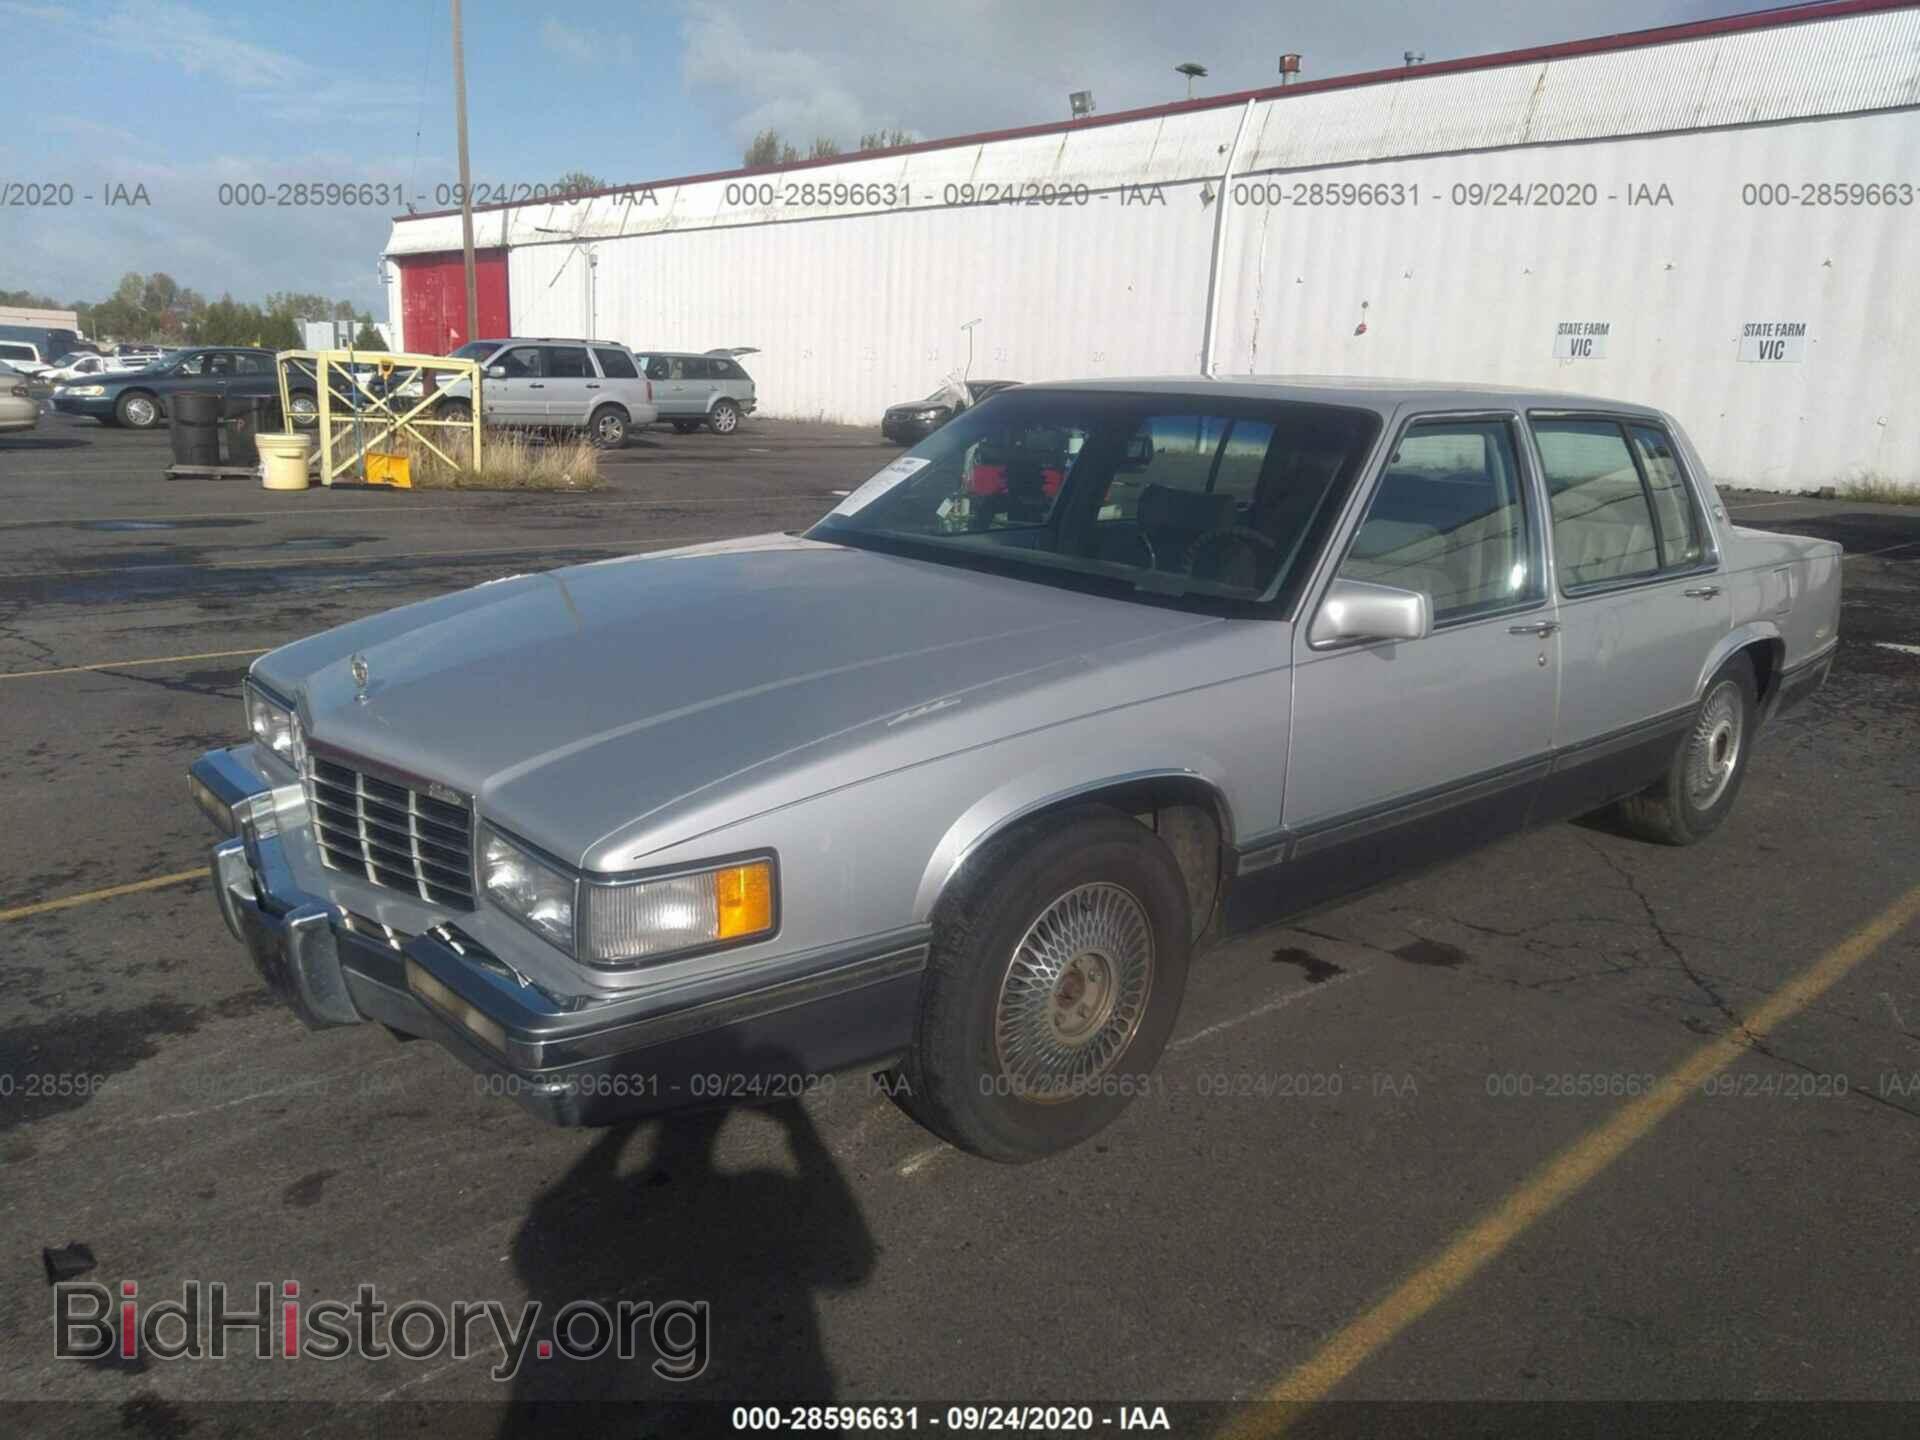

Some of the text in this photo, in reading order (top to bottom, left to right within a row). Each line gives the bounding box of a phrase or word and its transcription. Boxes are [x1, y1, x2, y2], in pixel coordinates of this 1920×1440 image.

[1557, 322, 1610, 335] STATE FARM
[1743, 323, 1807, 337] STATE FARM
[1570, 338, 1592, 357] VIC
[1758, 340, 1786, 360] VIC
